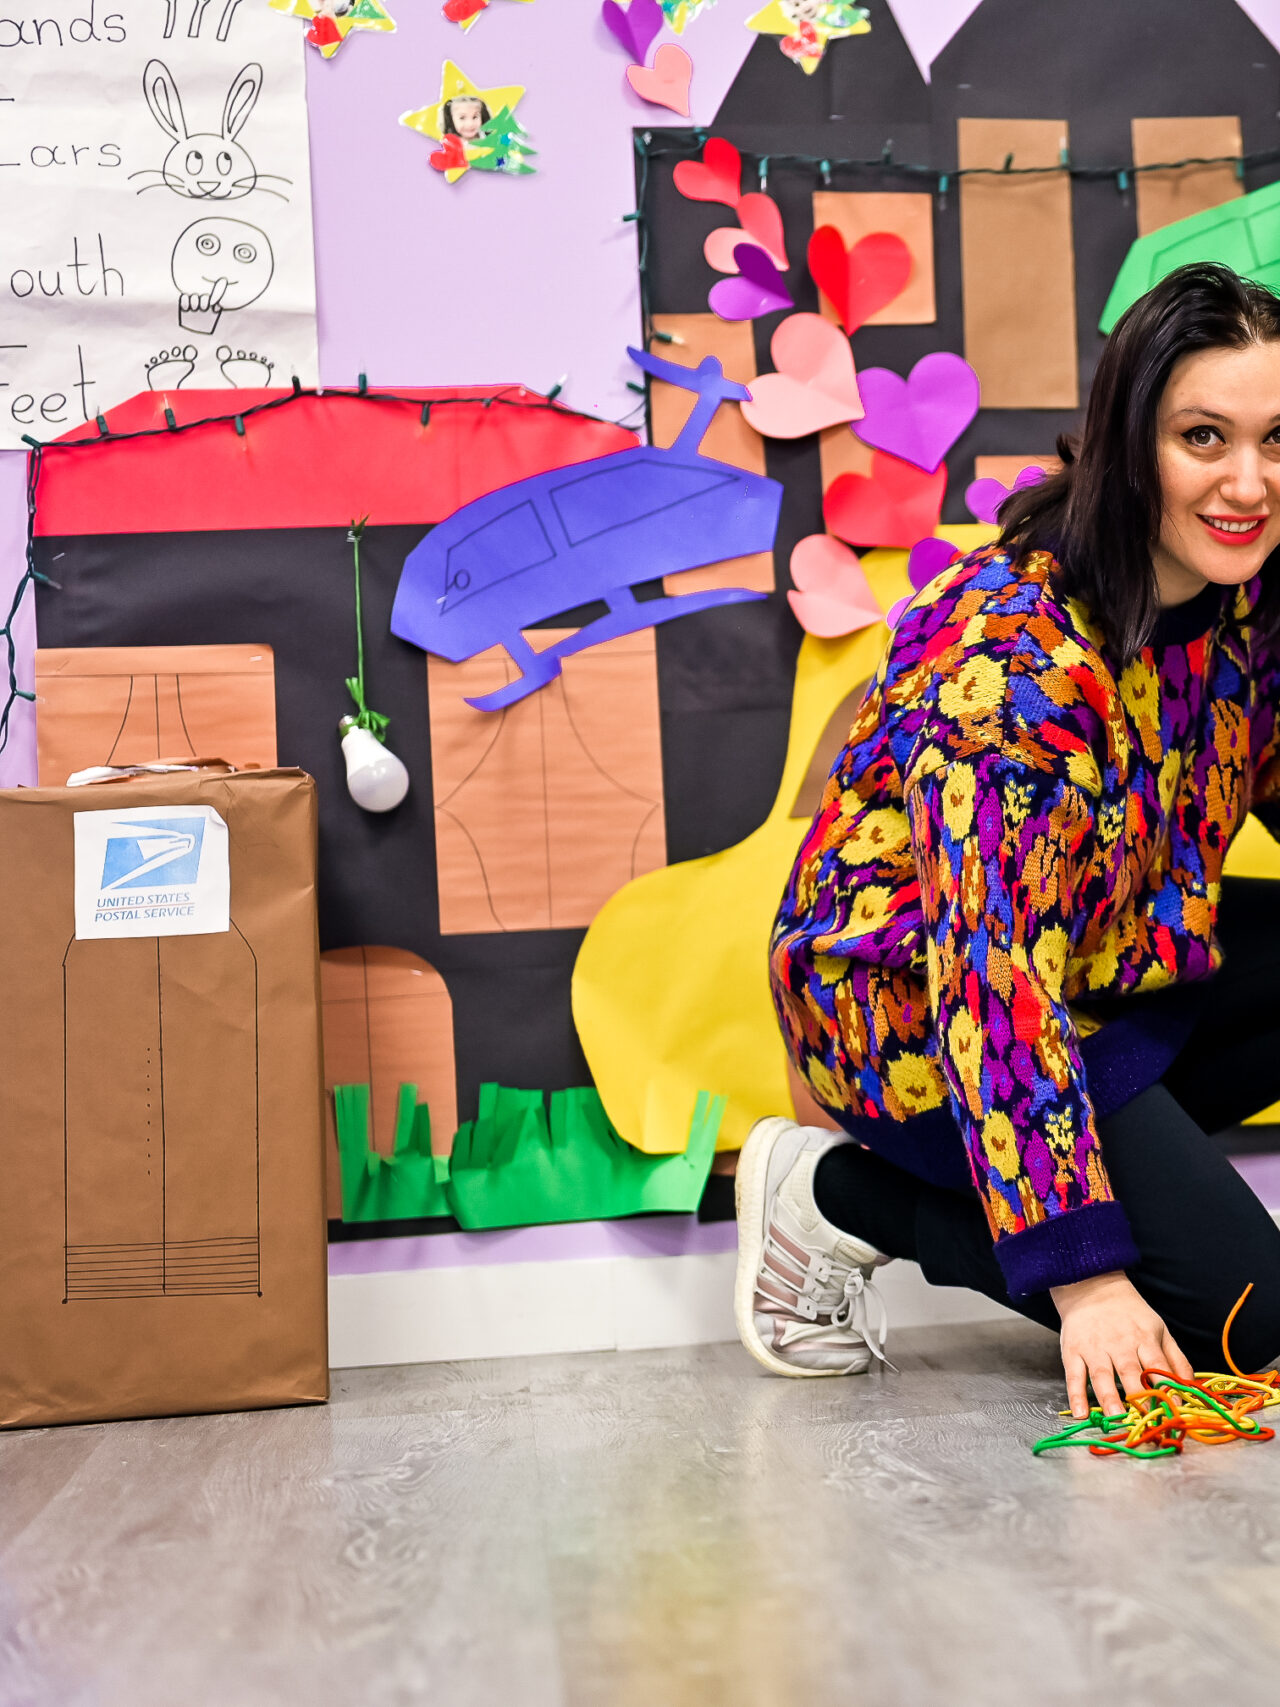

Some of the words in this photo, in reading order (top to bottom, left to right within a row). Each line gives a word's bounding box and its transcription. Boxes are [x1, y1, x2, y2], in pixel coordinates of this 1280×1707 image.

[10, 234, 124, 298] outh
[97, 896, 145, 908] UNITED
[147, 892, 190, 905] STATES
[94, 910, 142, 922] POSTAL
[144, 906, 195, 918] SERVICE
